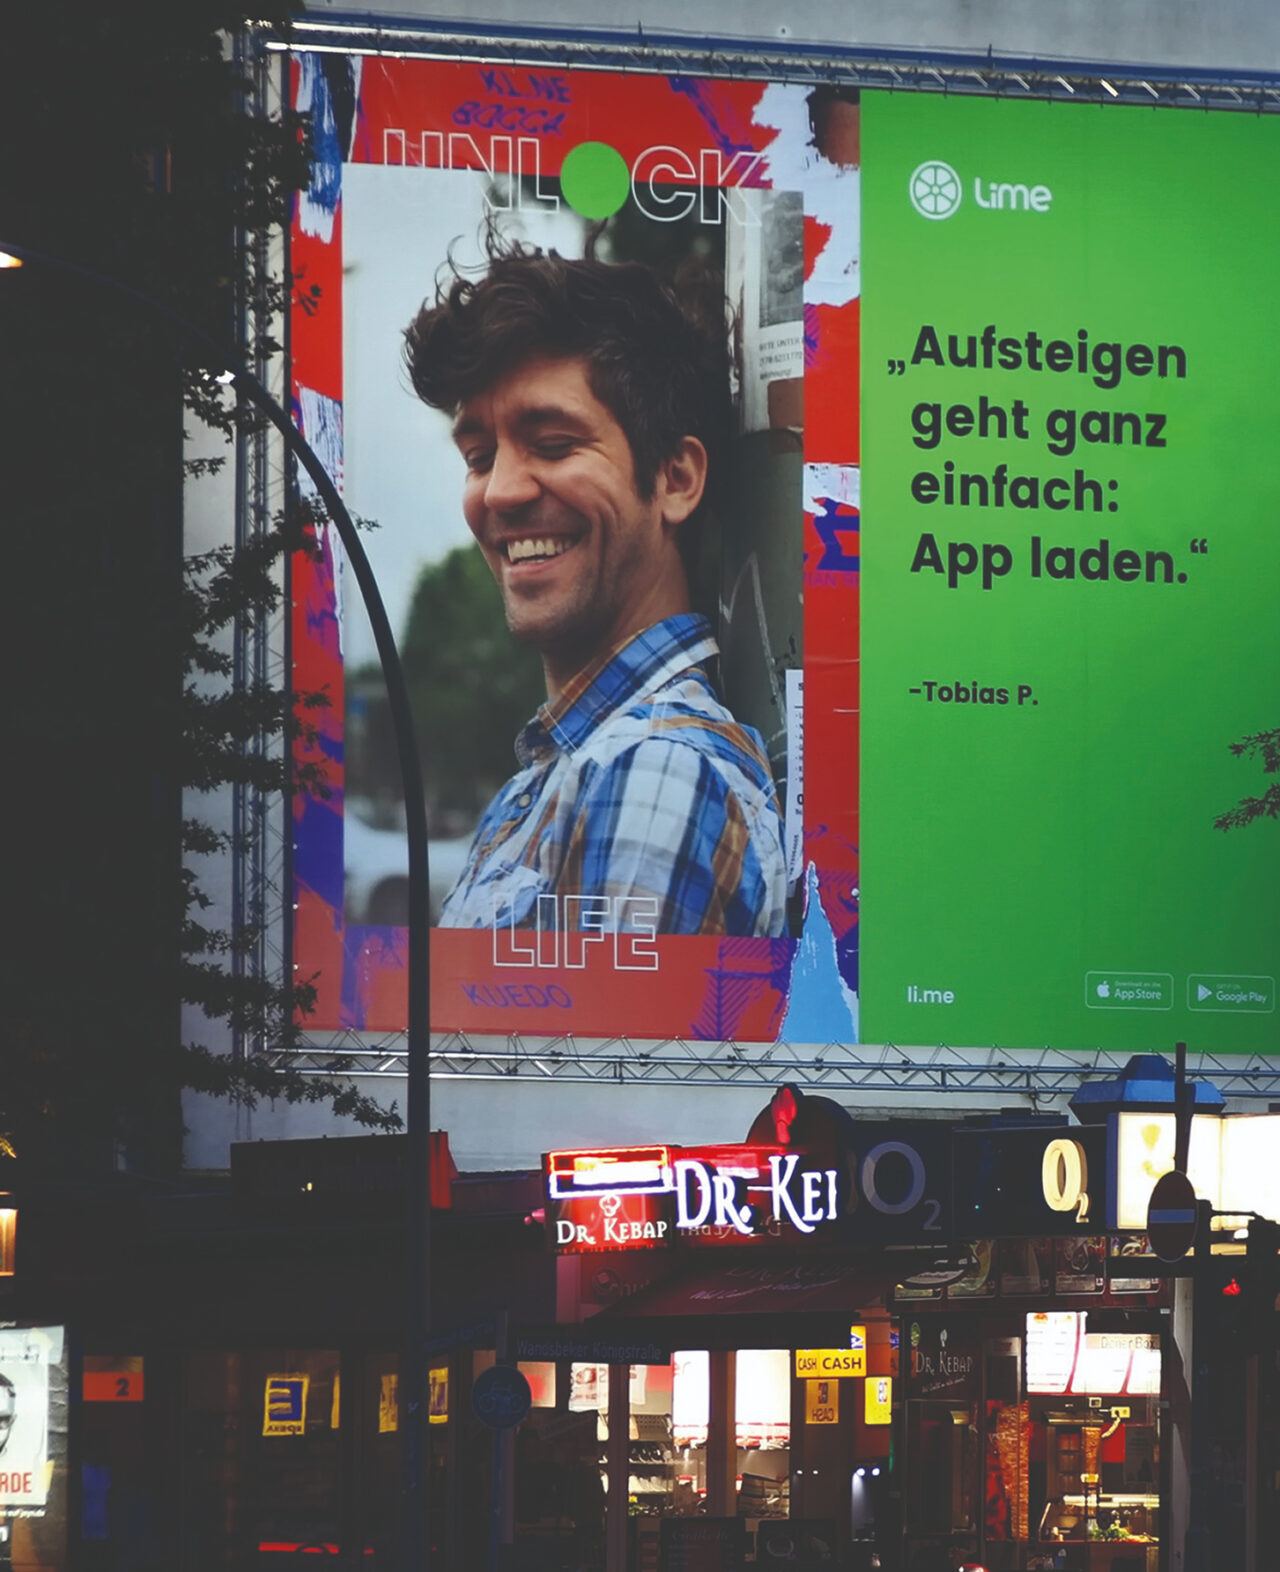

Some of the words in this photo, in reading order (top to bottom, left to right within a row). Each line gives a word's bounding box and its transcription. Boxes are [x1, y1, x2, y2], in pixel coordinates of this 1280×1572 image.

[974, 177, 1052, 212] Lime
[911, 395, 1029, 450] geht
[1046, 408, 1168, 456] ganz
[911, 460, 1118, 513] einfach:
[910, 533, 1013, 590] App
[1018, 685, 1038, 706] P.
[493, 892, 659, 971] LIFE
[907, 985, 955, 1004] li.me
[1114, 989, 1134, 1001] App
[1136, 988, 1162, 1000] Store
[1216, 991, 1247, 1004] Google
[1249, 992, 1267, 1004] Play
[604, 1217, 668, 1243] KEBAP
[797, 1358, 818, 1371] CASH
[822, 1356, 863, 1370] CASH
[939, 1351, 974, 1377] KEBAP
[115, 1378, 130, 1397] 2
